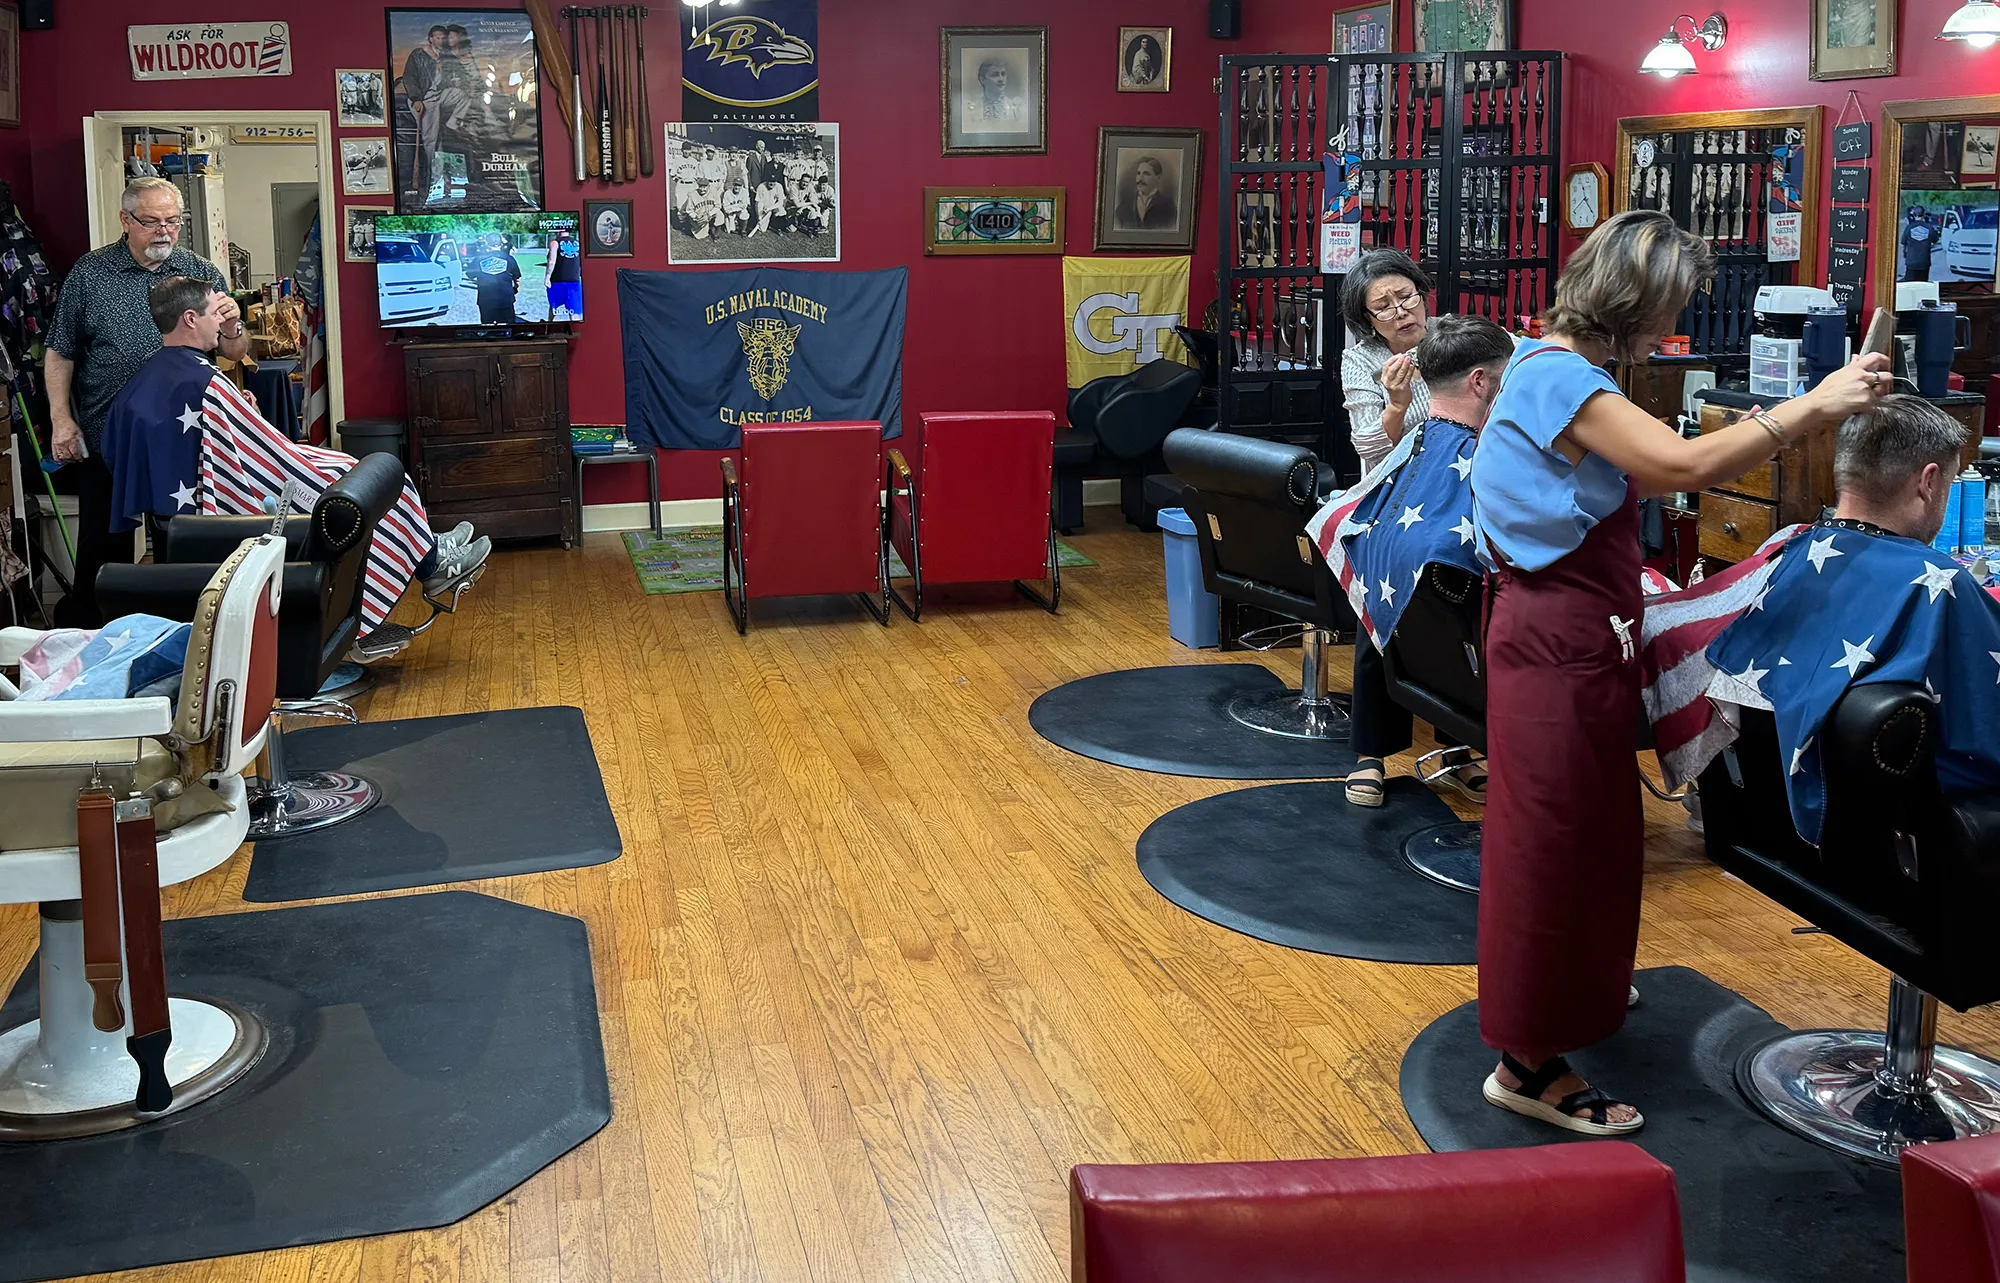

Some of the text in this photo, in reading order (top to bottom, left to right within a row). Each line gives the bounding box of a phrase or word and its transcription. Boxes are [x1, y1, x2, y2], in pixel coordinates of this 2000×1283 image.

[167, 29, 224, 41] ASK FOR
[133, 41, 259, 72] WILDROOT
[602, 121, 612, 175] LOUISVILLE
[491, 153, 518, 162] BULL
[482, 162, 528, 171] DURHAM
[981, 215, 1011, 228] 1410
[1837, 220, 1856, 231] 9-6
[1835, 247, 1859, 255] Wednesday
[1835, 282, 1854, 291] Thursday
[705, 288, 828, 325] U.S. NAVAL ACADEMY
[751, 319, 787, 331] 1954
[1073, 292, 1181, 364] GT
[719, 406, 812, 426] CLASS OF 1954
[294, 487, 316, 505] SMART
[447, 563, 462, 578] N
